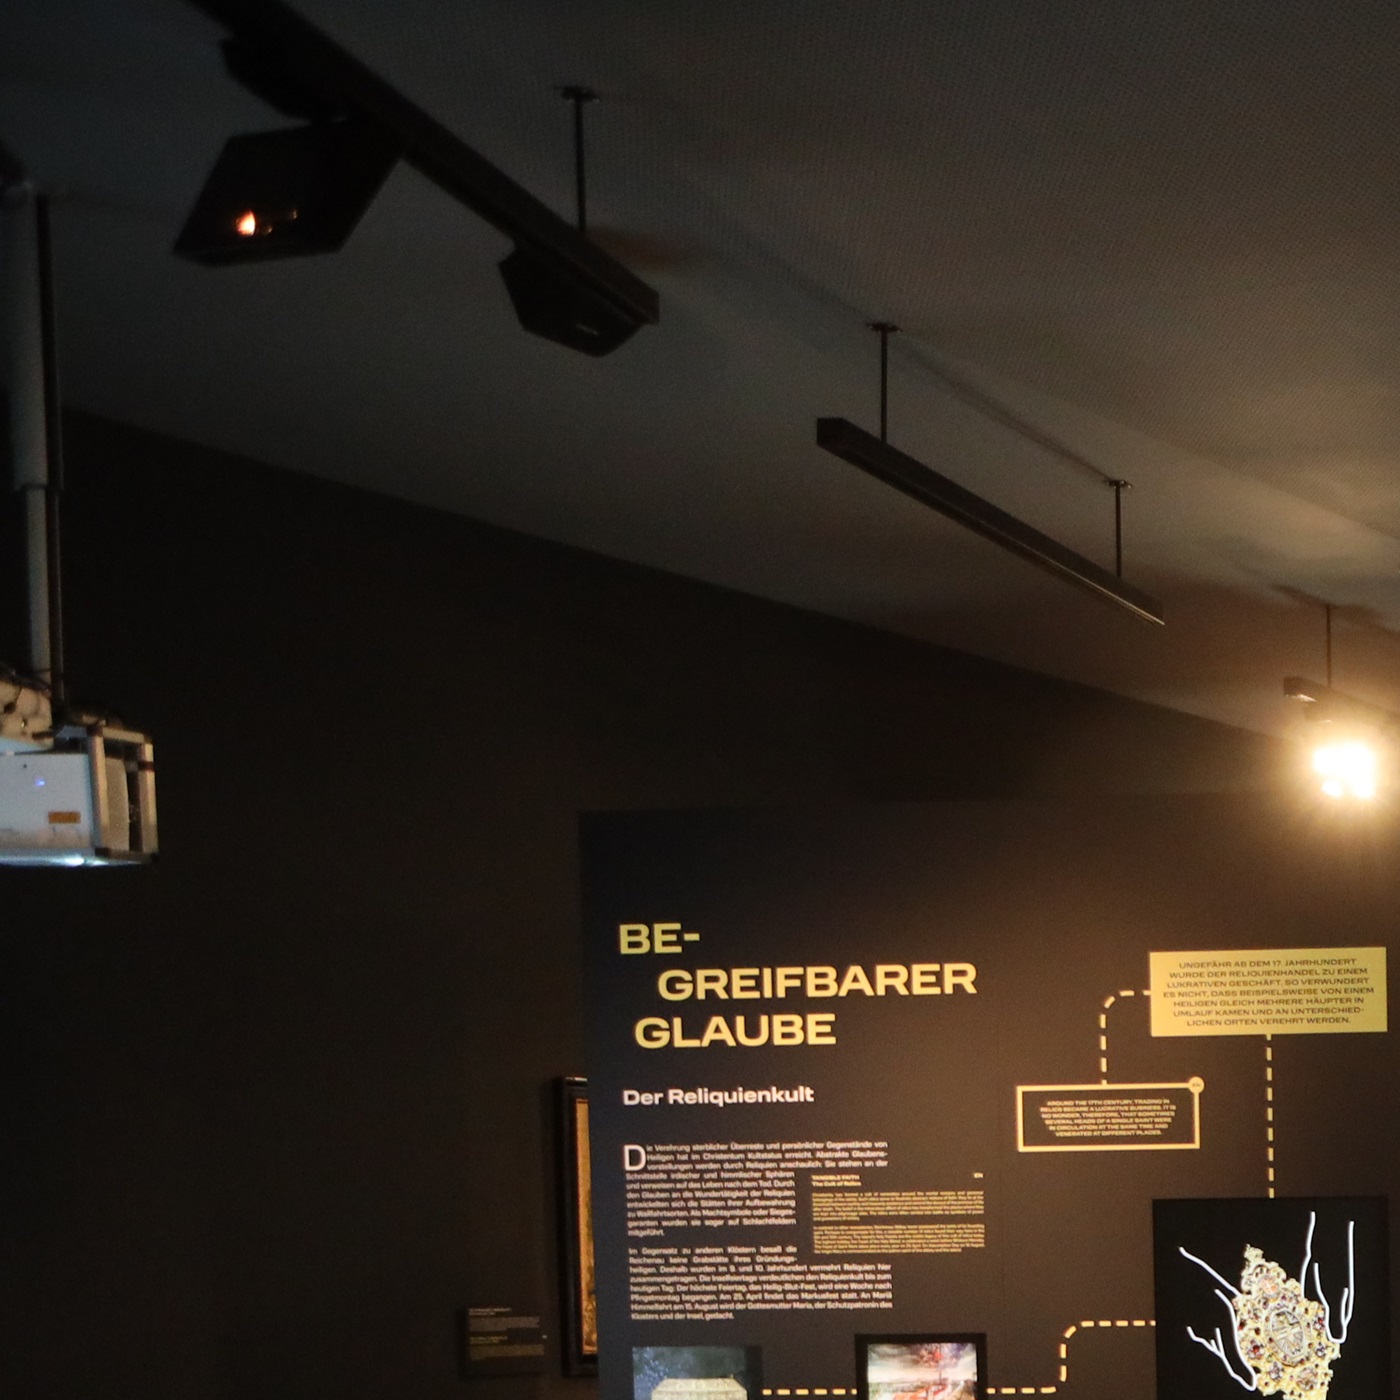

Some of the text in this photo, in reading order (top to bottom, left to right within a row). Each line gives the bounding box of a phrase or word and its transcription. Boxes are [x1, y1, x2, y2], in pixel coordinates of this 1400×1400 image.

[619, 923, 700, 954] BE-
[1285, 958, 1356, 967] JAHRHUNDERT
[1229, 969, 1320, 977] RELIQUIENHANDEL
[657, 963, 977, 1001] GREIFBARER
[1167, 980, 1226, 988] LUKRATIVEN
[1301, 978, 1369, 986] VERWUNDERT
[1178, 990, 1209, 998] NICHT,
[1240, 988, 1318, 996] BEISPIELSWEISE
[1257, 998, 1304, 1006] MEHRERE
[1306, 997, 1352, 1005] HÄUPTER
[634, 1013, 837, 1049] GLAUBE
[623, 1086, 814, 1108] Der Reliquienkult
[766, 1143, 780, 1151] und
[874, 1141, 887, 1149] von
[647, 1153, 674, 1162] Heiligen
[677, 1153, 689, 1161] hat
[691, 1153, 700, 1161] im
[703, 1152, 745, 1161] Christentum
[816, 1151, 849, 1159] Abstrakte
